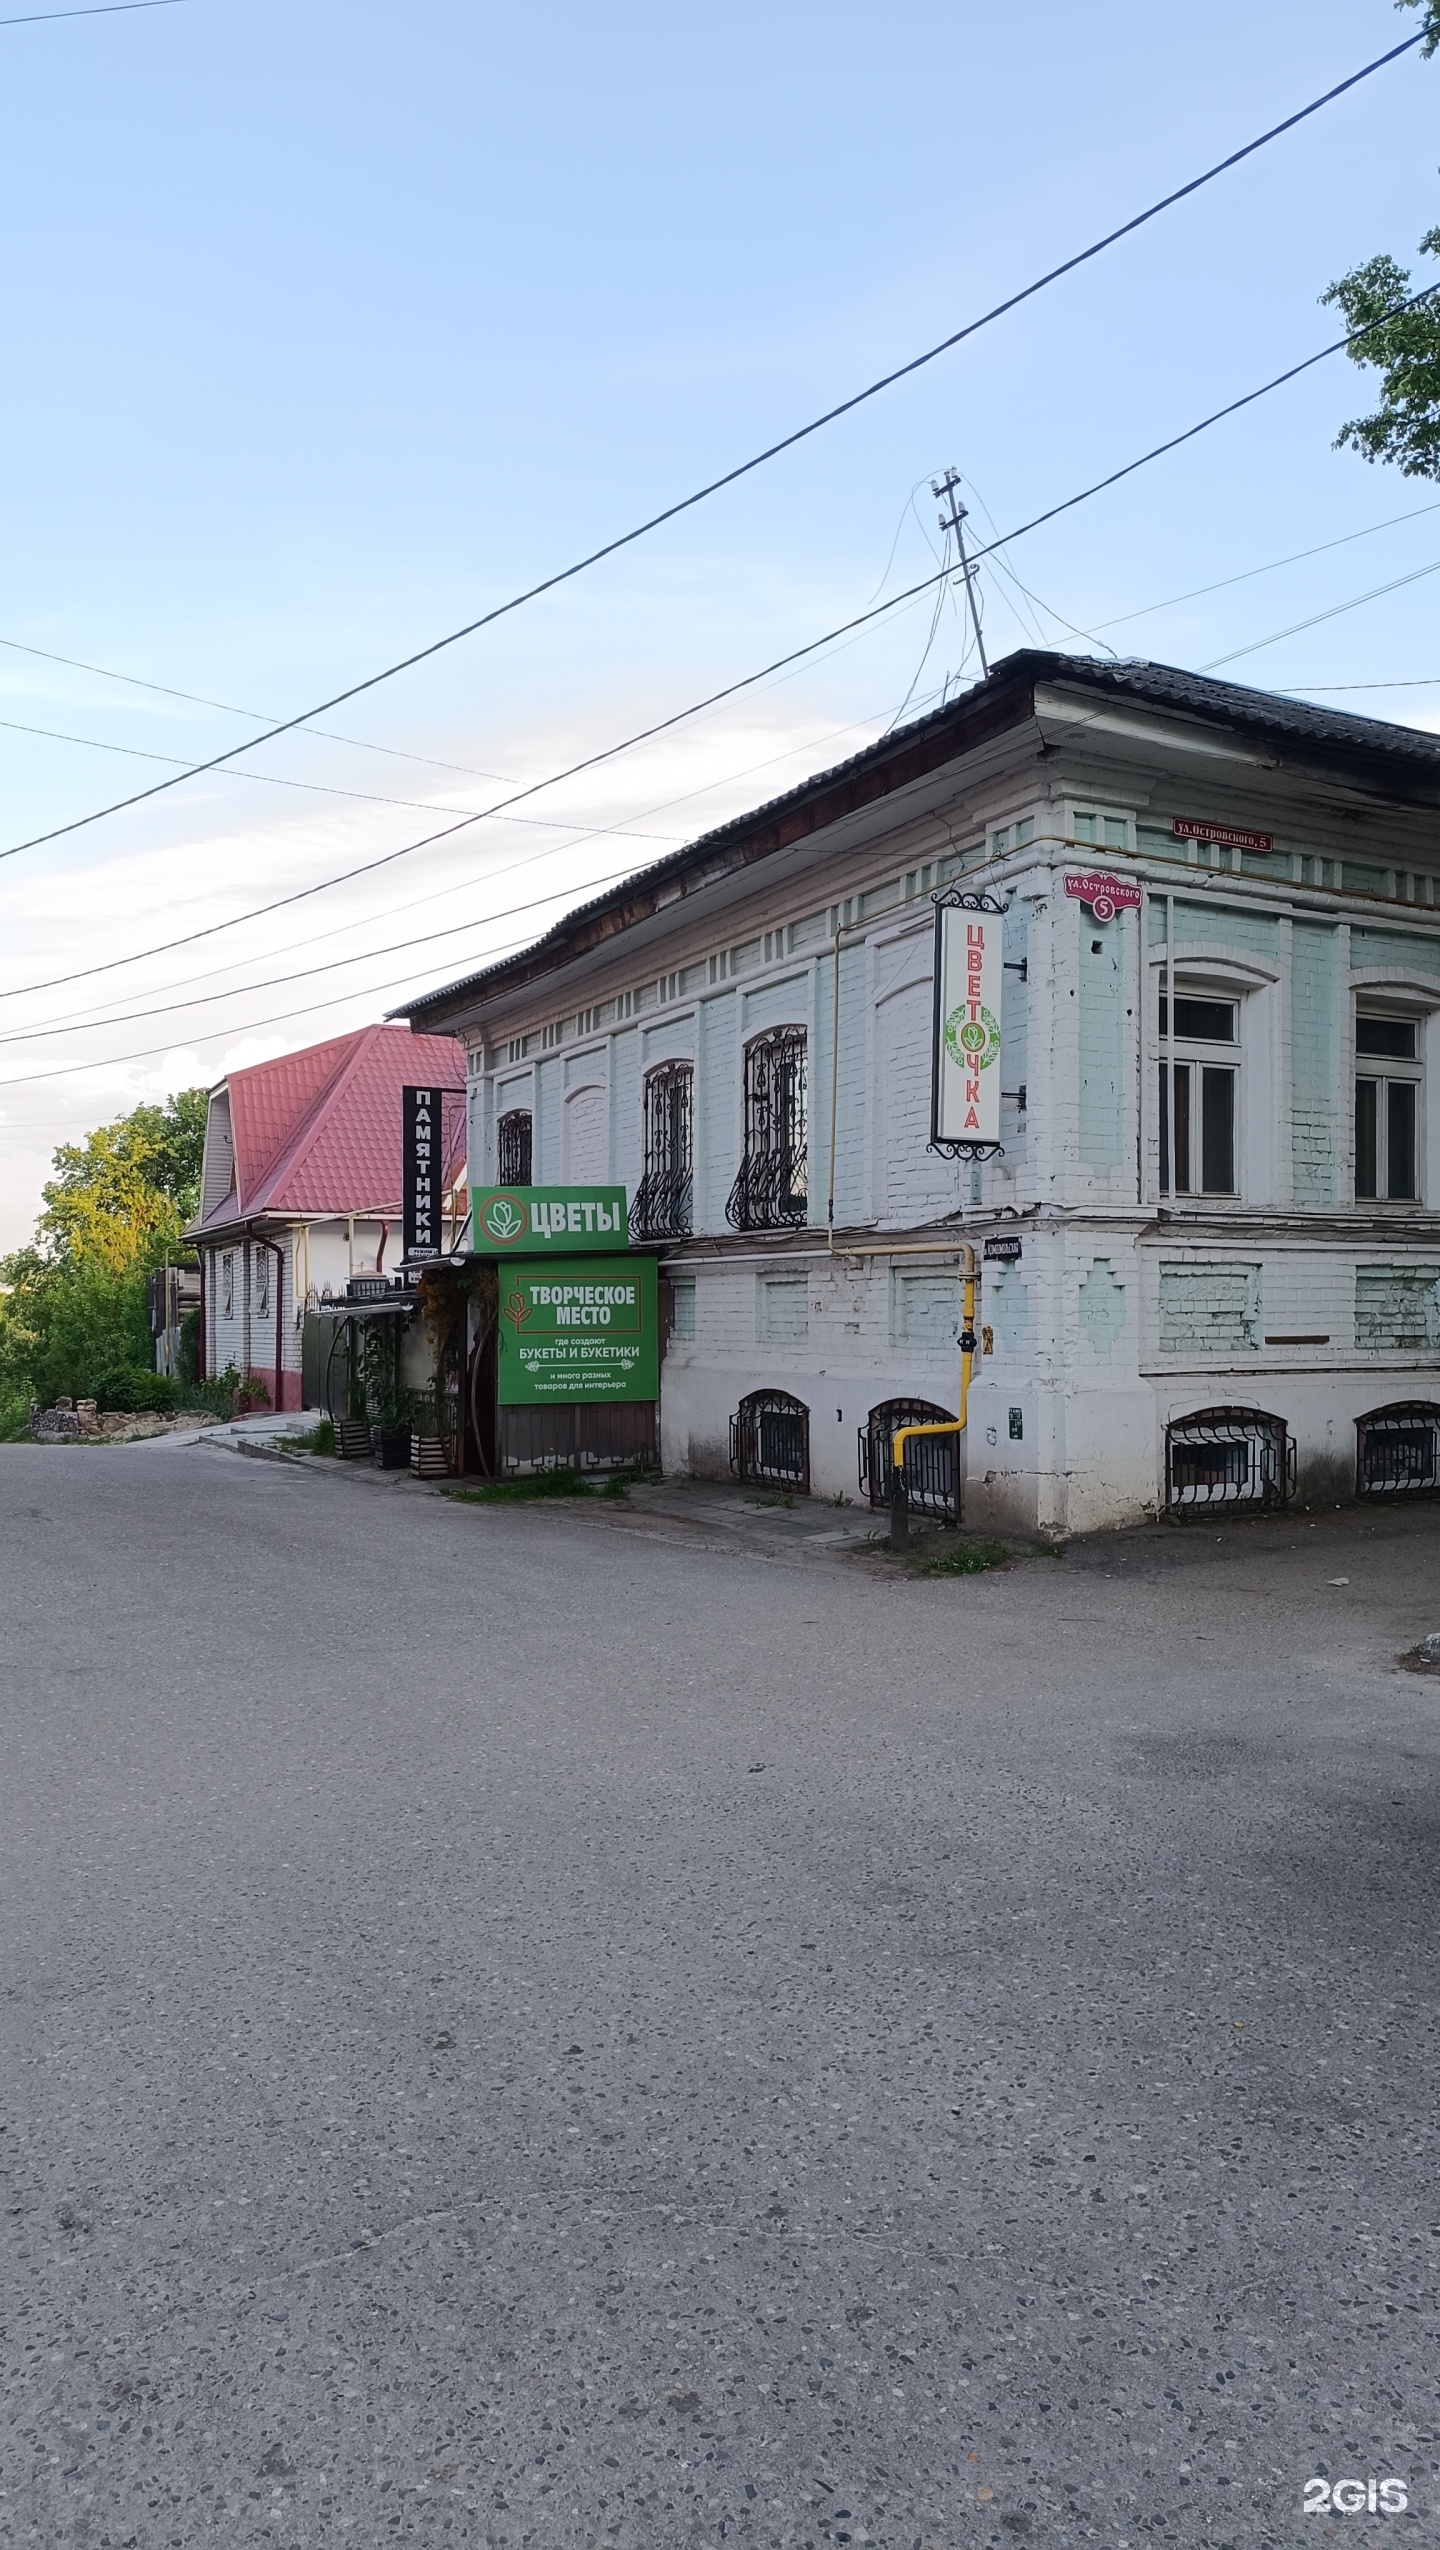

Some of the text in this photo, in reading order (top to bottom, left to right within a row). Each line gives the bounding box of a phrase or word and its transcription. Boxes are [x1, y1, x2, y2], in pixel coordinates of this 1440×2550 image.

[1259, 837, 1267, 848] 5
[1100, 900, 1109, 916] 5
[415, 1090, 431, 1244] ПАМЯТНИКИ
[530, 1202, 620, 1239] ЦВЕТЫ
[529, 1286, 635, 1305] ТВОРЧЕСКОЕ
[556, 1306, 611, 1325] МЕСТО
[570, 1338, 606, 1346] создают
[519, 1347, 639, 1359] БУКЕТЫ И БУКЕТИКИ
[582, 1372, 611, 1380] разных
[534, 1381, 626, 1391] товаров для интерьера
